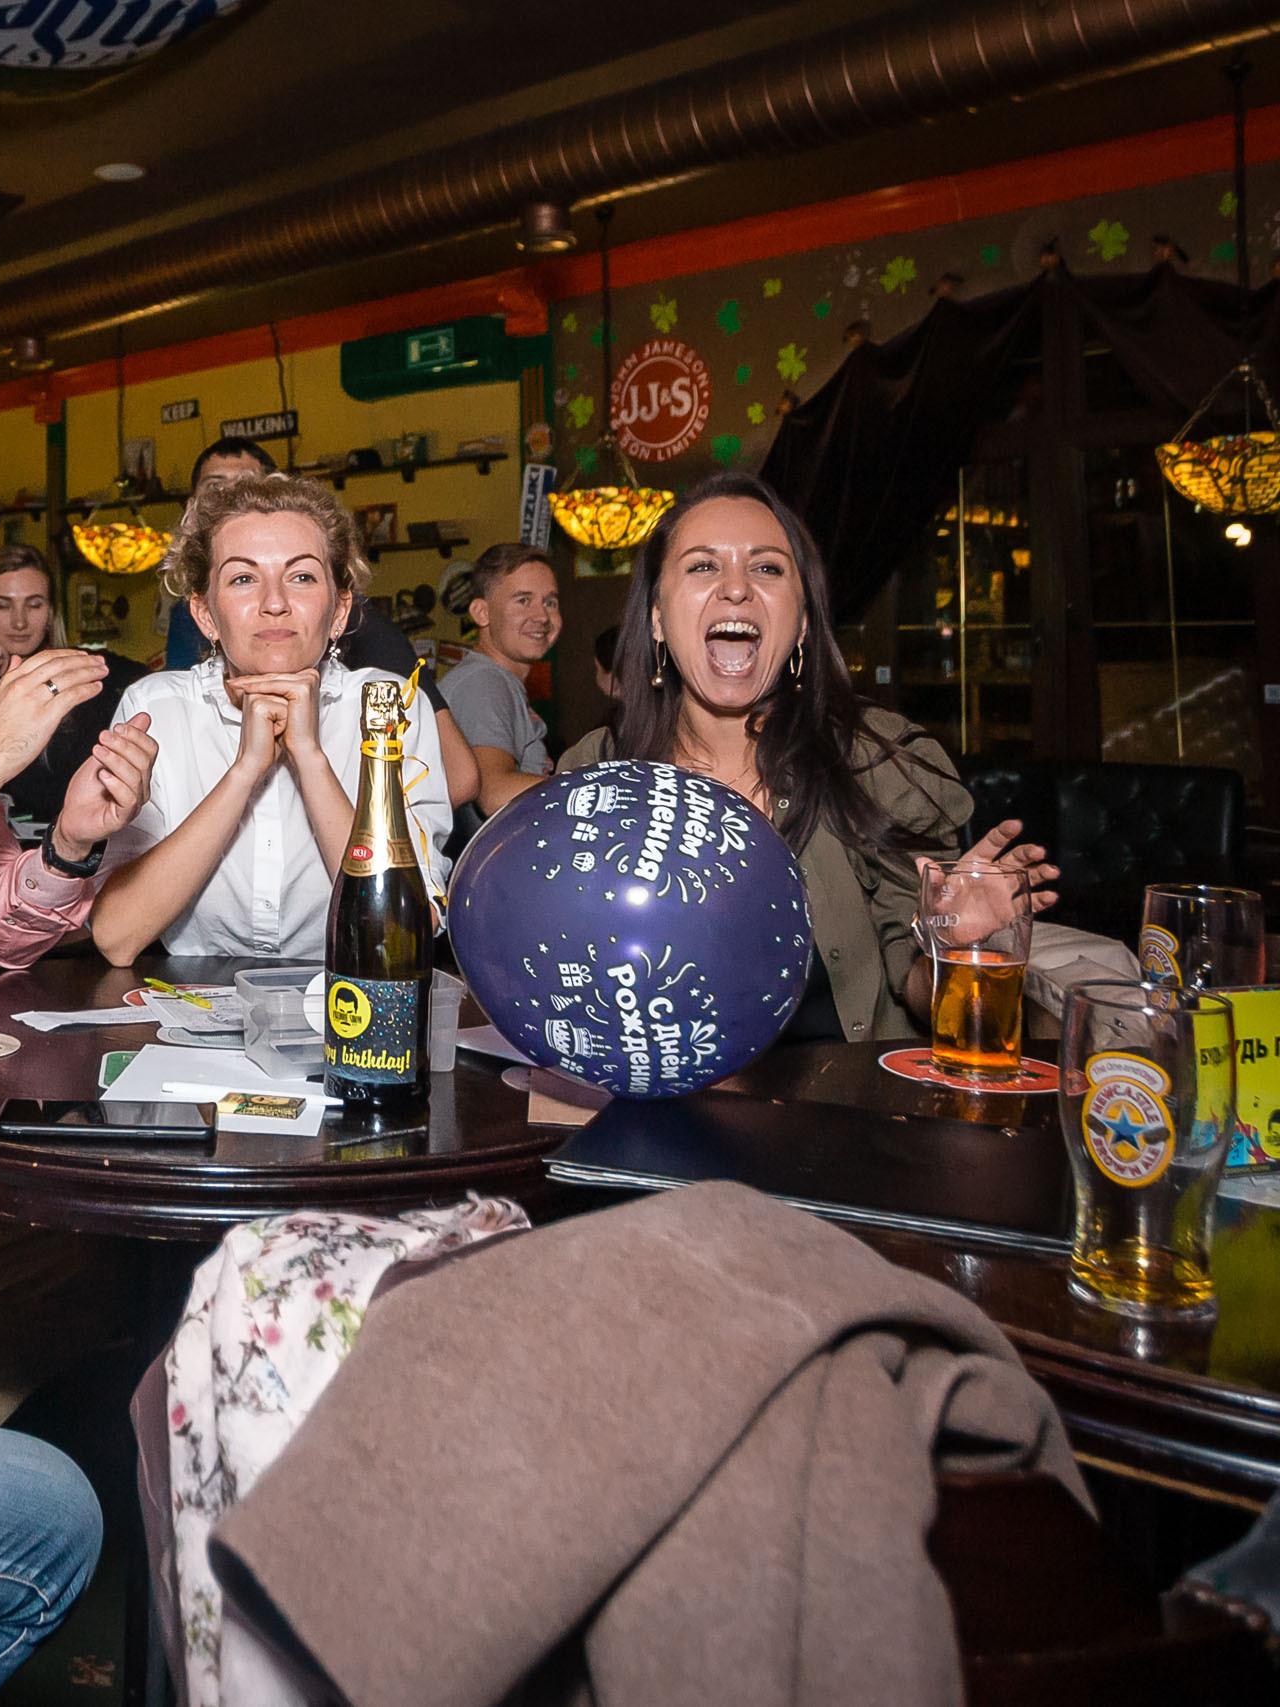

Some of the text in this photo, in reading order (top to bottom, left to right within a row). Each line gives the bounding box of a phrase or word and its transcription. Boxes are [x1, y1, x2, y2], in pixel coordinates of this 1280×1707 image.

[642, 340, 710, 390] JAMESON
[162, 402, 195, 422] KEEP
[620, 376, 693, 425] JJ&S
[619, 430, 650, 460] SON
[655, 404, 710, 462] LIMITED
[342, 1045, 411, 1075] birthday!
[1091, 1083, 1161, 1123] NEWCASTLE
[1093, 1137, 1161, 1178] BROWN ALE
